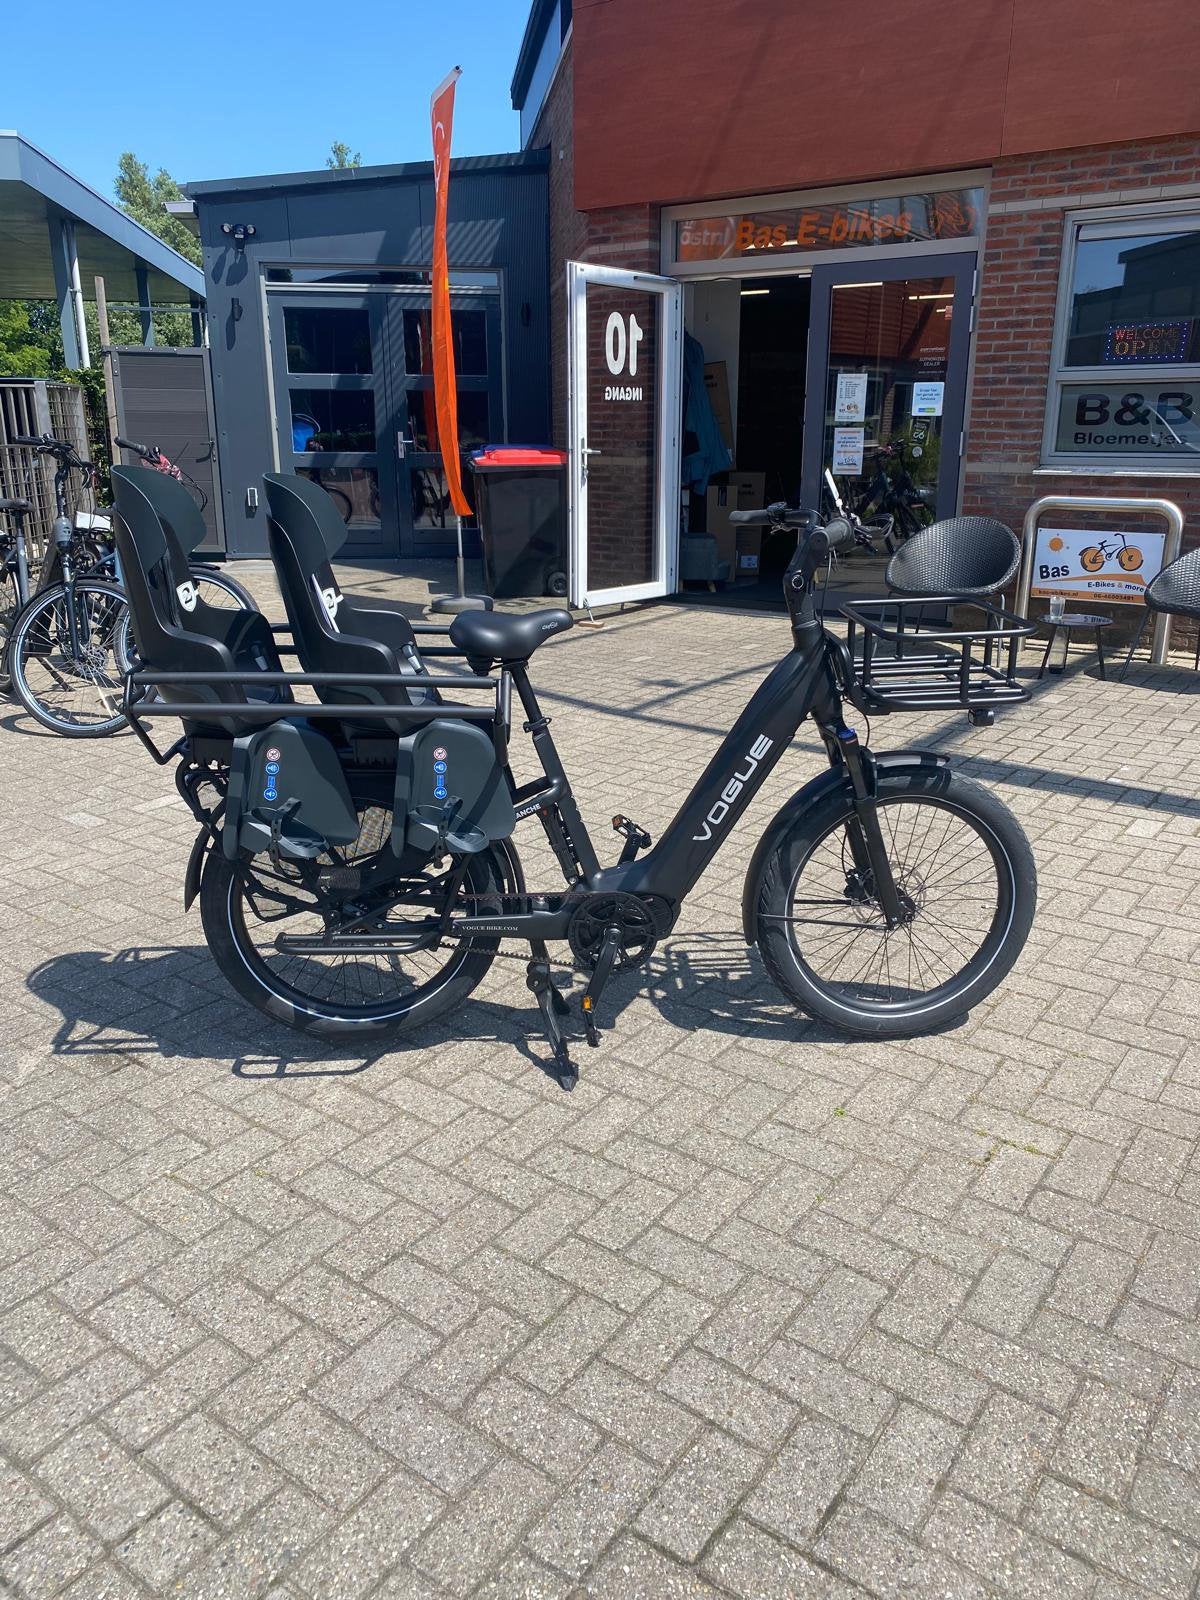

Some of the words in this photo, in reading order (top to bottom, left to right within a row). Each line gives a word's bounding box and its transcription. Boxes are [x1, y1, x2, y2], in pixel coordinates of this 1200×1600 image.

[736, 219, 788, 249] Bas
[798, 208, 912, 245] E-bikes
[1115, 328, 1178, 340] WELCOME
[1114, 340, 1177, 355] OPEN
[1075, 392, 1194, 426] B&B
[1039, 564, 1070, 579] Bas
[1124, 584, 1145, 592] more
[692, 734, 774, 840] VOGUE
